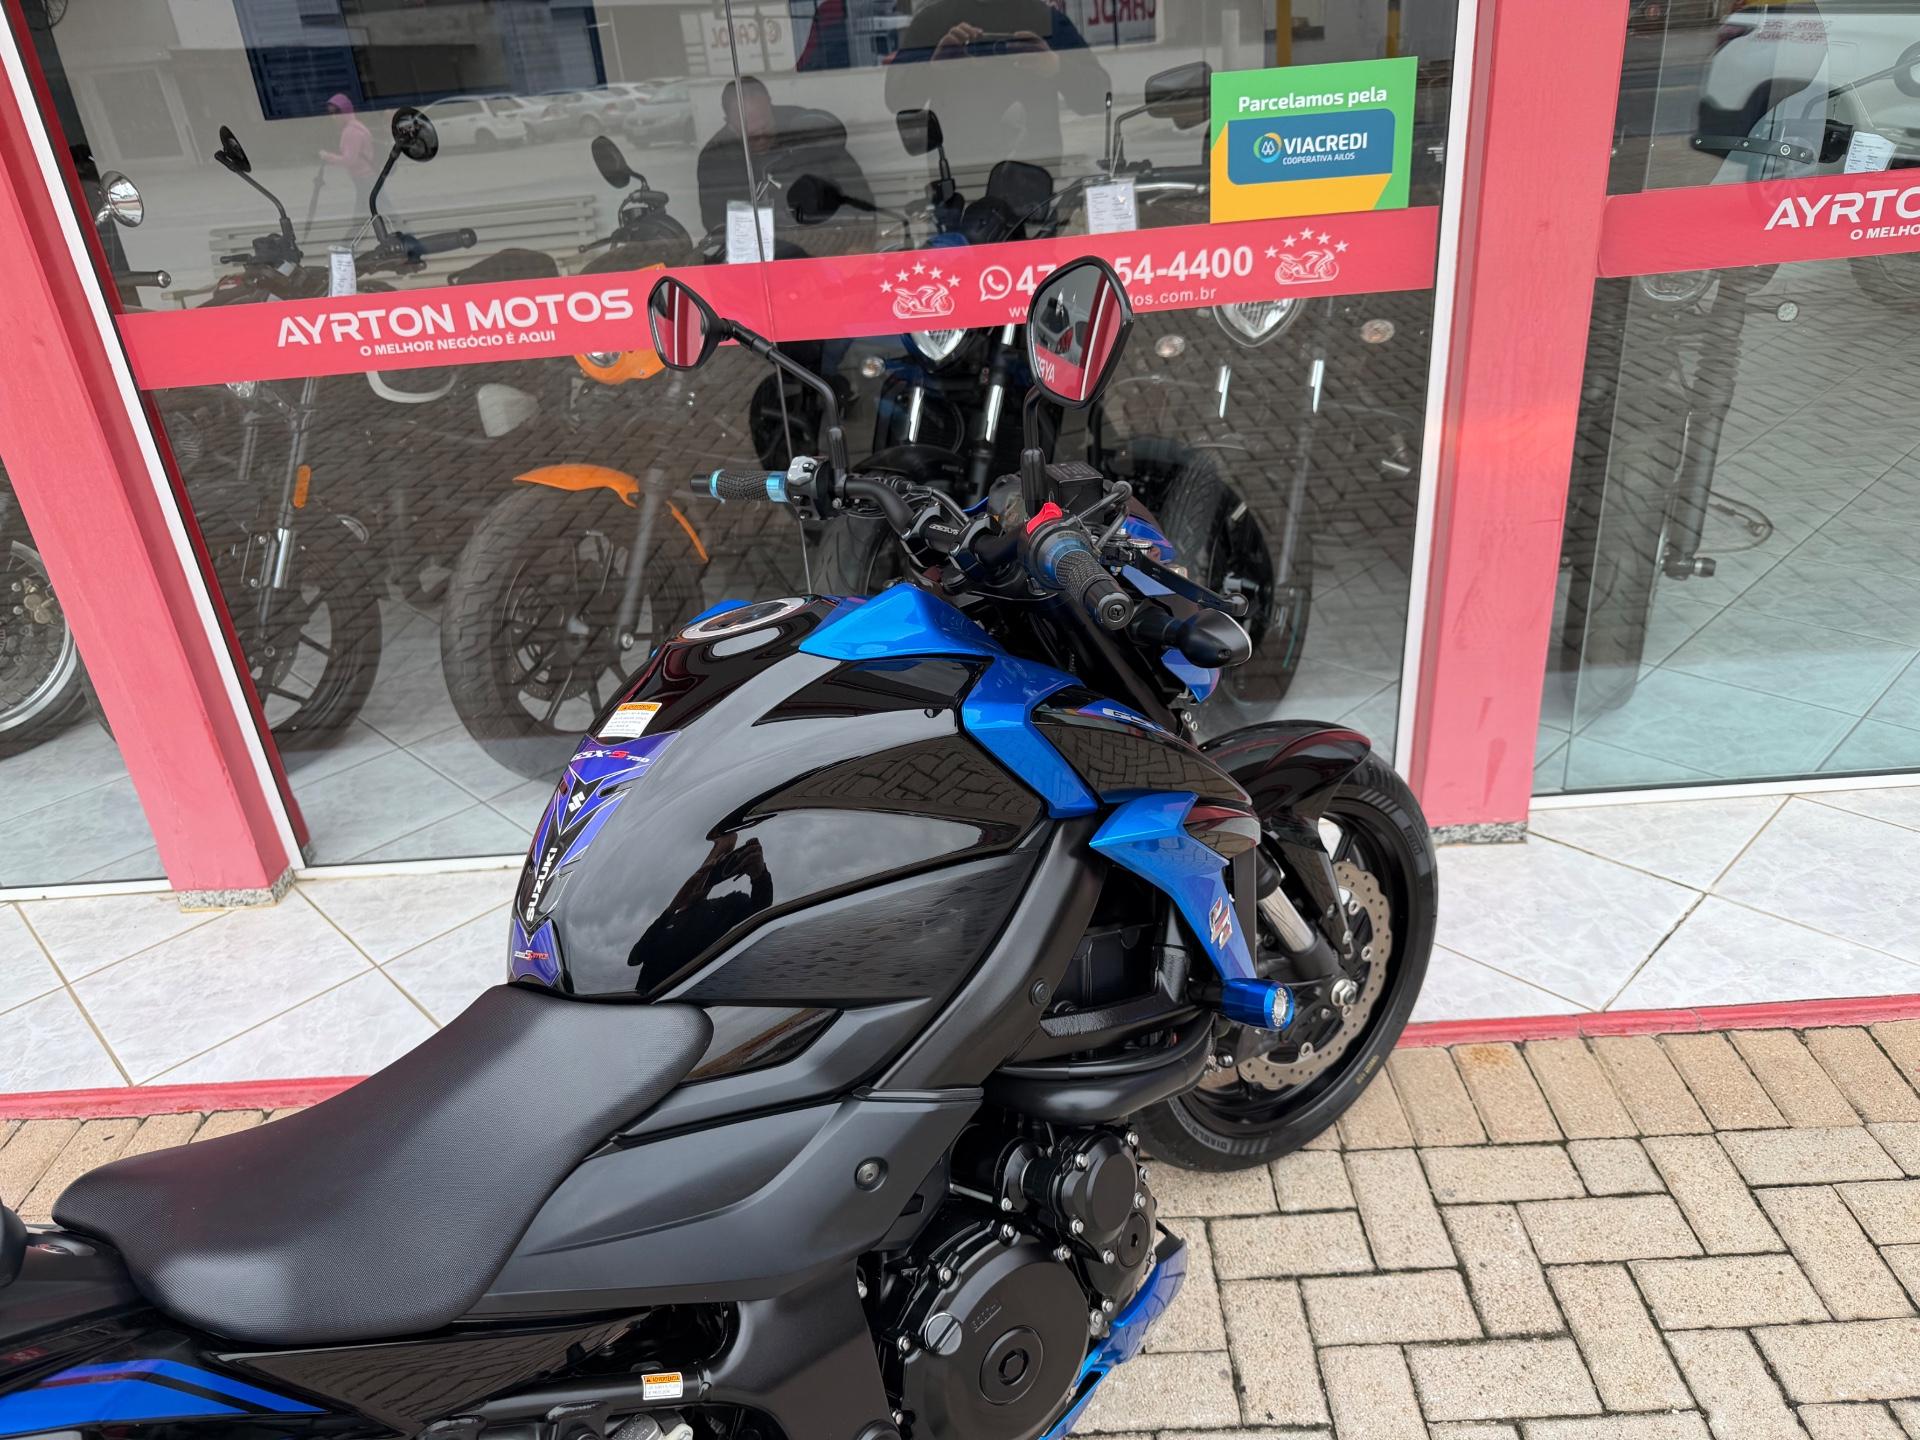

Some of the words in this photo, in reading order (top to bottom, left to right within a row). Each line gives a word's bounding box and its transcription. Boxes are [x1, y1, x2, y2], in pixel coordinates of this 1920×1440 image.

[1238, 92, 1344, 112] Parcelamos
[1347, 86, 1387, 108] pela
[1283, 132, 1368, 154] VIACREDI
[1282, 155, 1333, 165] COOPERATIVA
[1850, 229, 1863, 240] O
[1866, 224, 1920, 240] MELHO
[277, 303, 459, 348] AYRTON
[465, 288, 634, 333] MOTOS
[360, 344, 372, 357] O
[375, 340, 434, 356] MELHOR
[437, 332, 503, 351] NEGÓCIO
[506, 329, 514, 345] É
[519, 330, 556, 345] AQUI
[526, 847, 558, 922] SUZUKI
